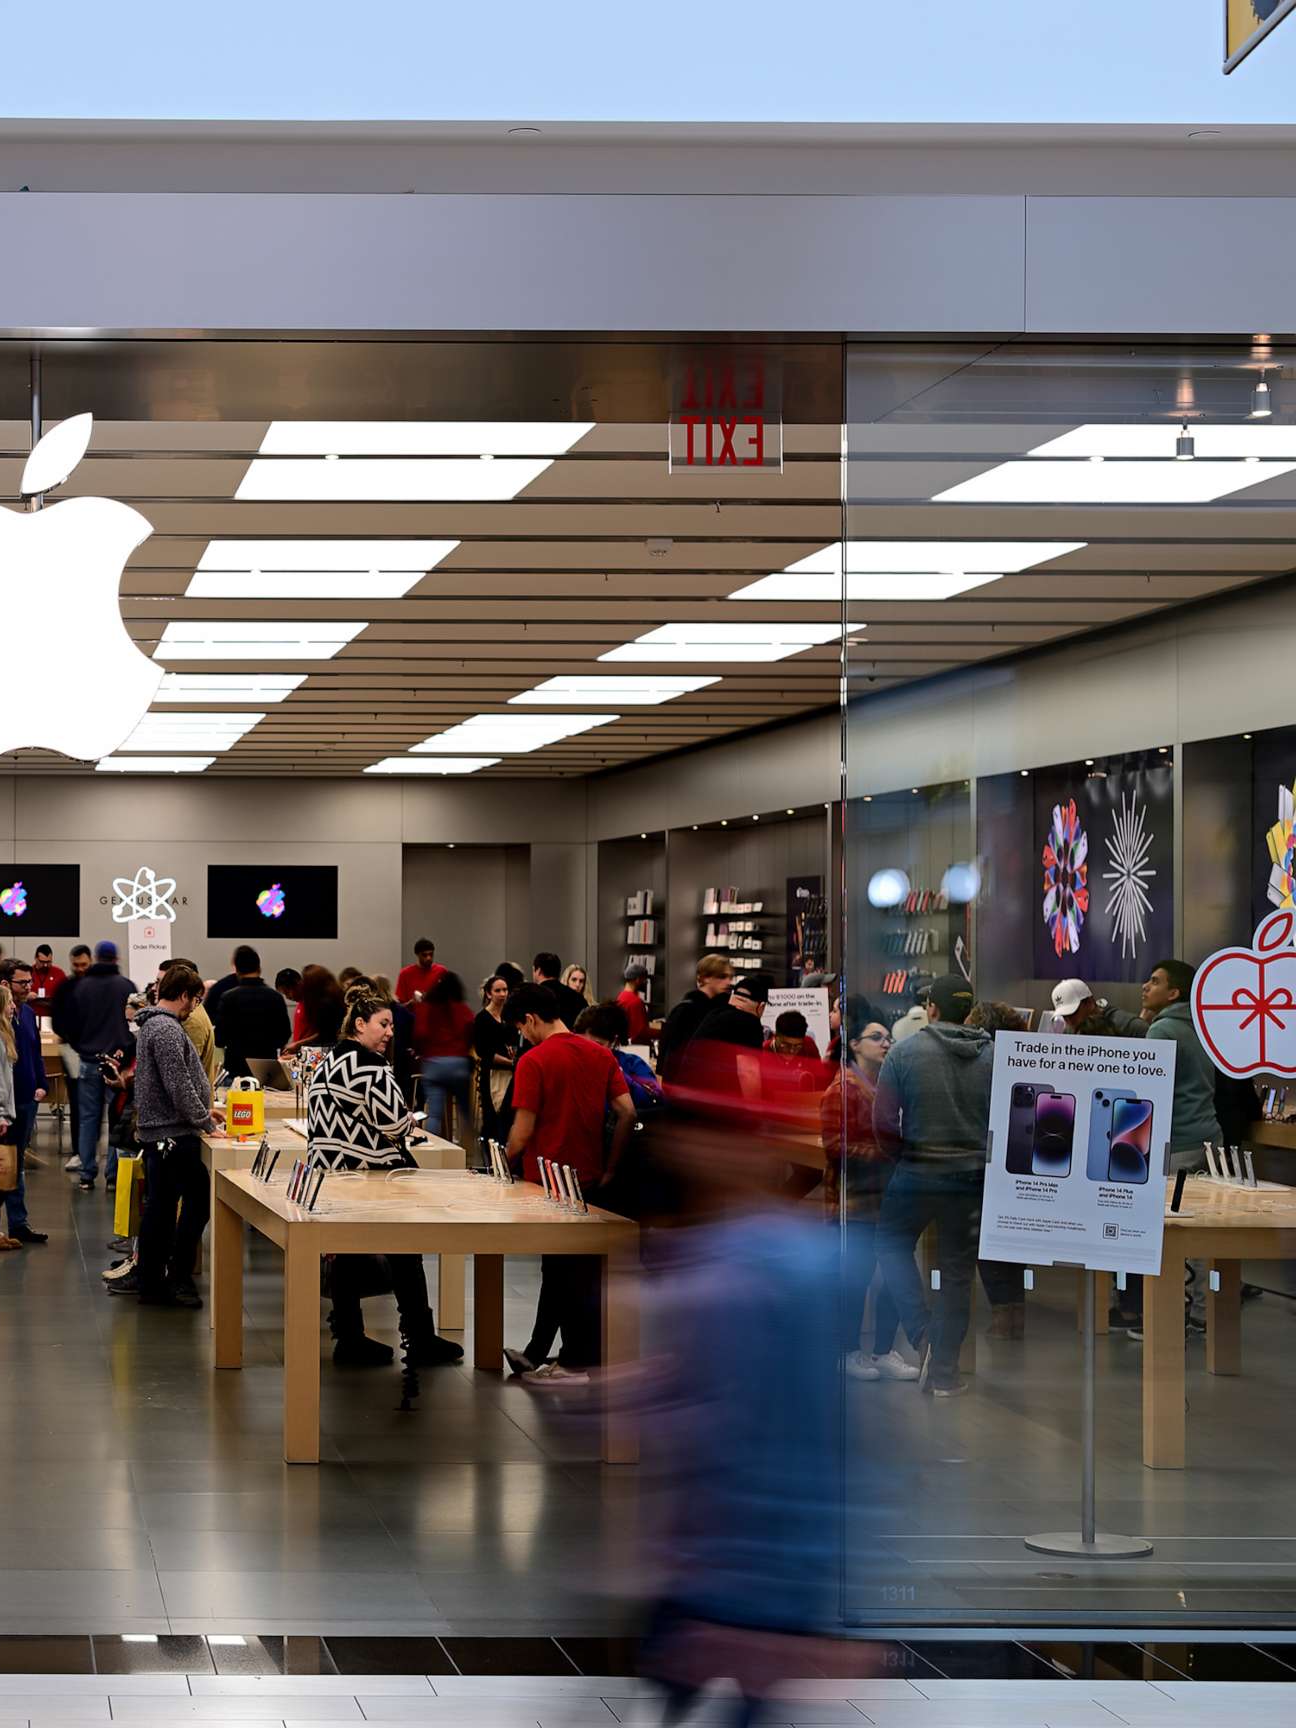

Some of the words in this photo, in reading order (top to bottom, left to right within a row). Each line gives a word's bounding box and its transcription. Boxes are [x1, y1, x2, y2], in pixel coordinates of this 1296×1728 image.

[164, 896, 188, 905] AR
[1014, 1040, 1048, 1054] Trade
[1051, 1042, 1062, 1055] in
[1065, 1044, 1085, 1056] the
[1087, 1045, 1130, 1059] iPhone
[1133, 1051, 1156, 1061] you
[1007, 1056, 1036, 1068] have
[1039, 1058, 1056, 1070] for
[1058, 1061, 1066, 1070] a
[1068, 1062, 1094, 1072] new
[1097, 1064, 1120, 1074] one
[1123, 1064, 1135, 1075] to
[1137, 1064, 1167, 1077] love.
[234, 1110, 251, 1119] LEGO
[880, 1584, 915, 1601] 1311
